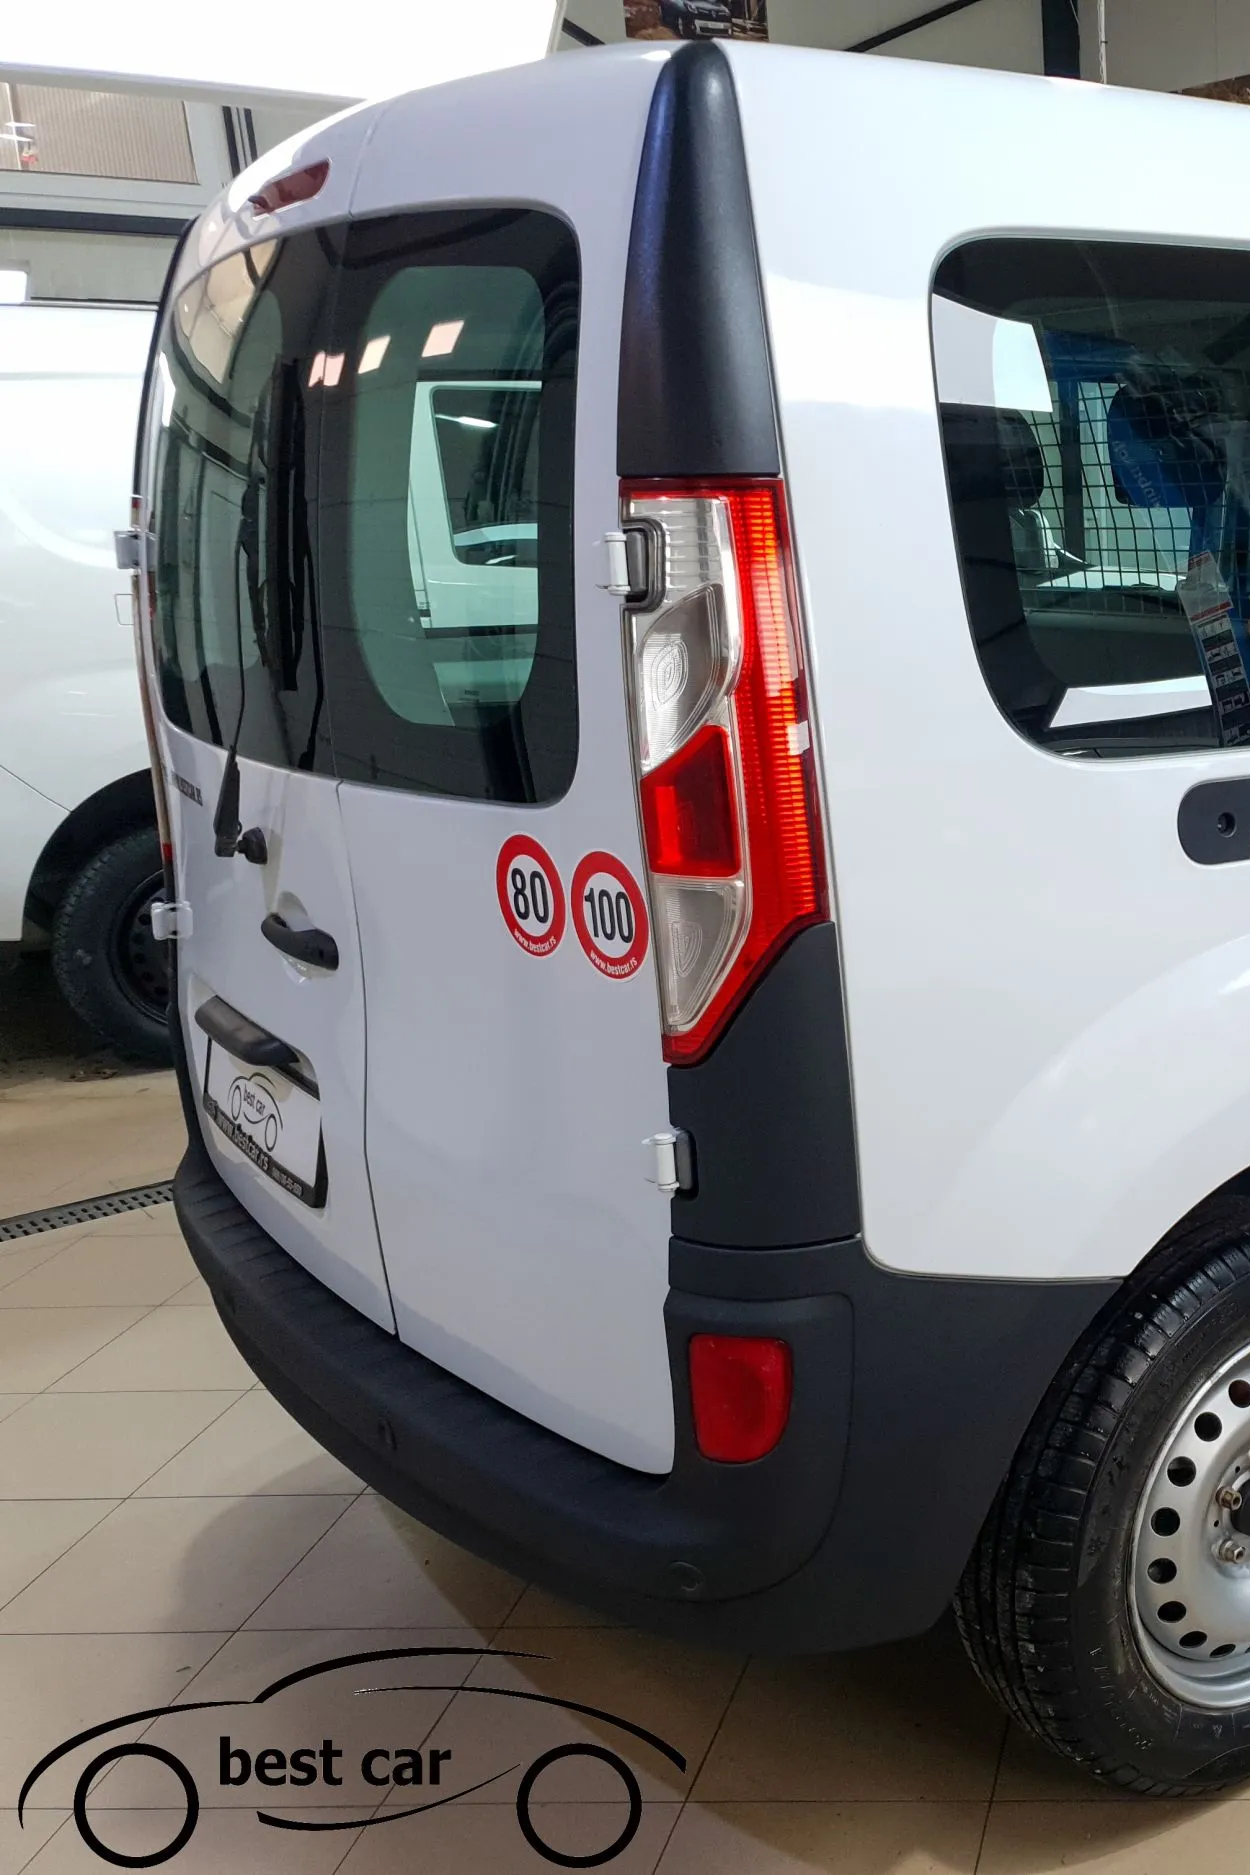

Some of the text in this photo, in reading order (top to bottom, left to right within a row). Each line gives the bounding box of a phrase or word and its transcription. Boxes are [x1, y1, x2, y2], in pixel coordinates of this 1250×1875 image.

[511, 867, 549, 924] 80
[584, 887, 634, 944] 100
[514, 928, 557, 953] www.bestcar.rs
[590, 950, 638, 975] www.bestcar.rs
[244, 1084, 255, 1109] best
